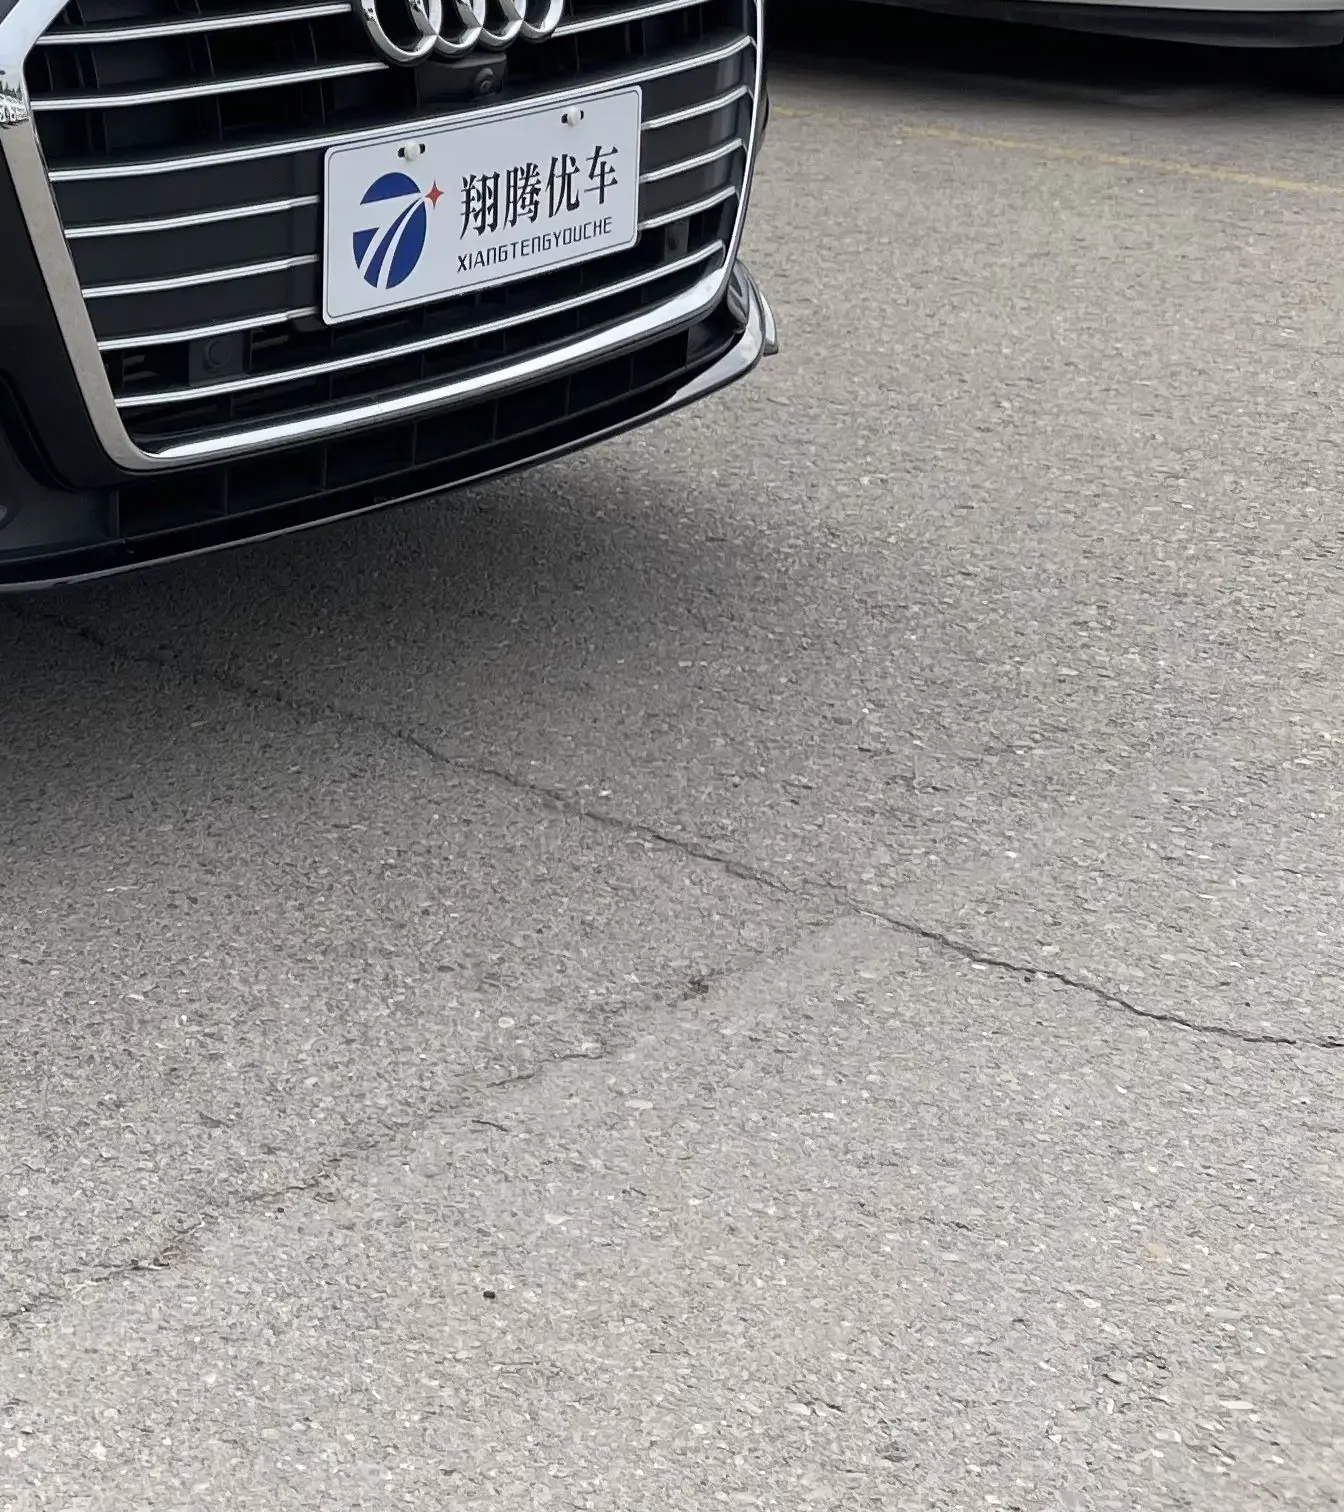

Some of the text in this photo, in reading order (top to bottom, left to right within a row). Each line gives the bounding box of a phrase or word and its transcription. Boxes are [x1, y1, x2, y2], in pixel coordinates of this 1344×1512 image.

[459, 144, 619, 241] 翔腾优车
[456, 215, 614, 274] XIANGTENGYOUCHE
